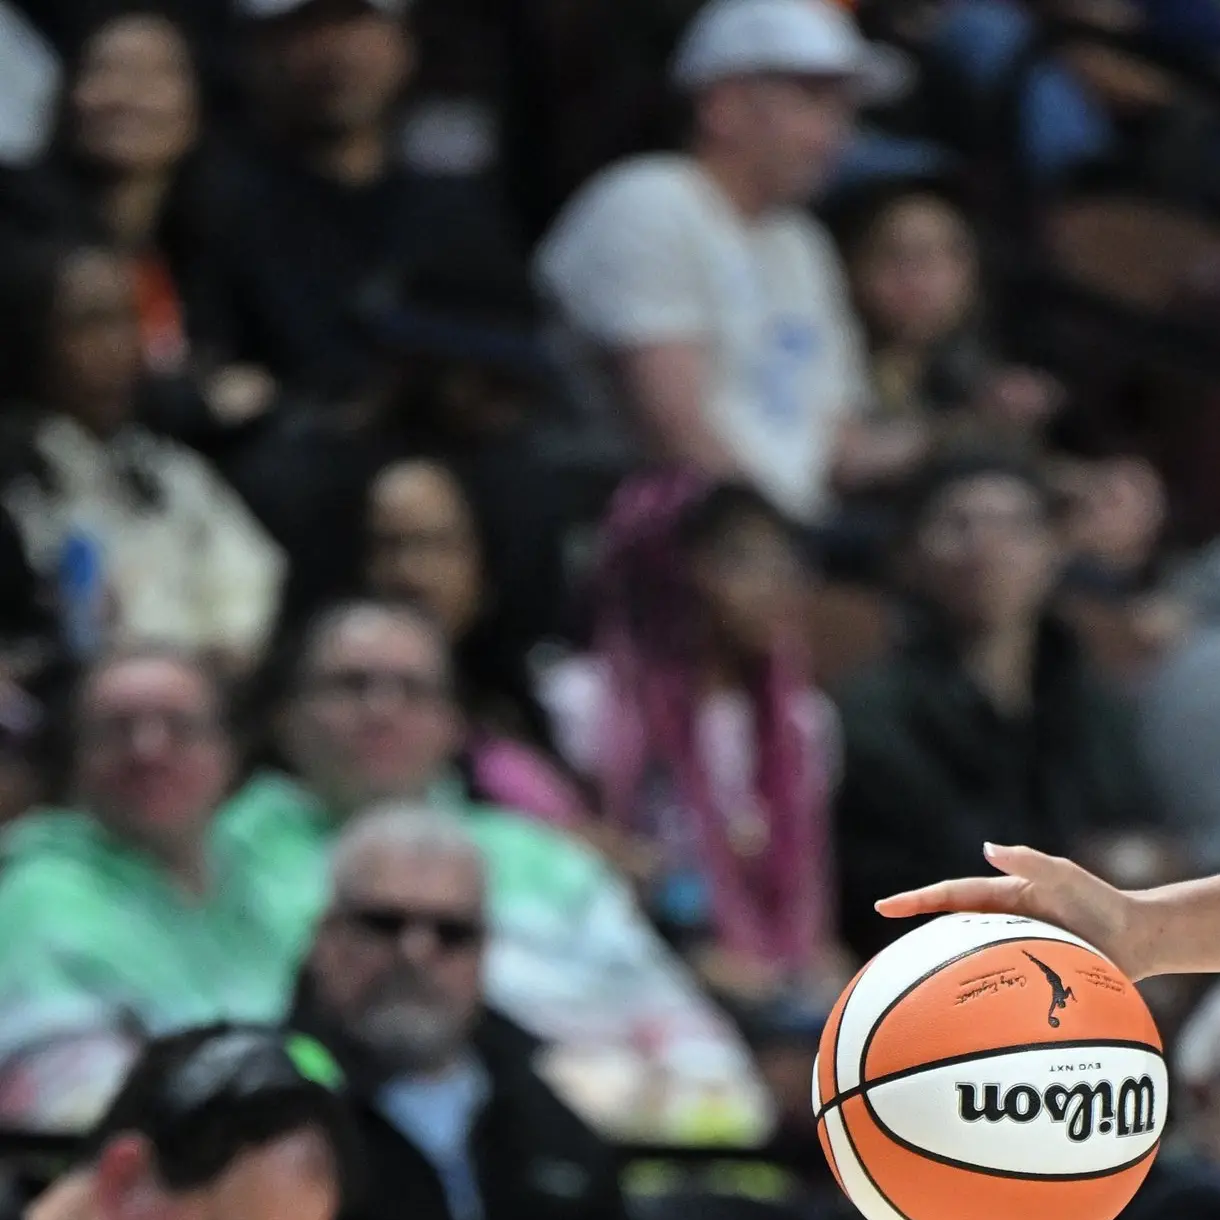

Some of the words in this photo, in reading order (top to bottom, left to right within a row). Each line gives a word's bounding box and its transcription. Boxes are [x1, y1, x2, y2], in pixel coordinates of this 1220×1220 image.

[1049, 1063, 1074, 1072] NXT
[1078, 1062, 1102, 1071] EVO
[955, 1073, 1156, 1143] Wilson
